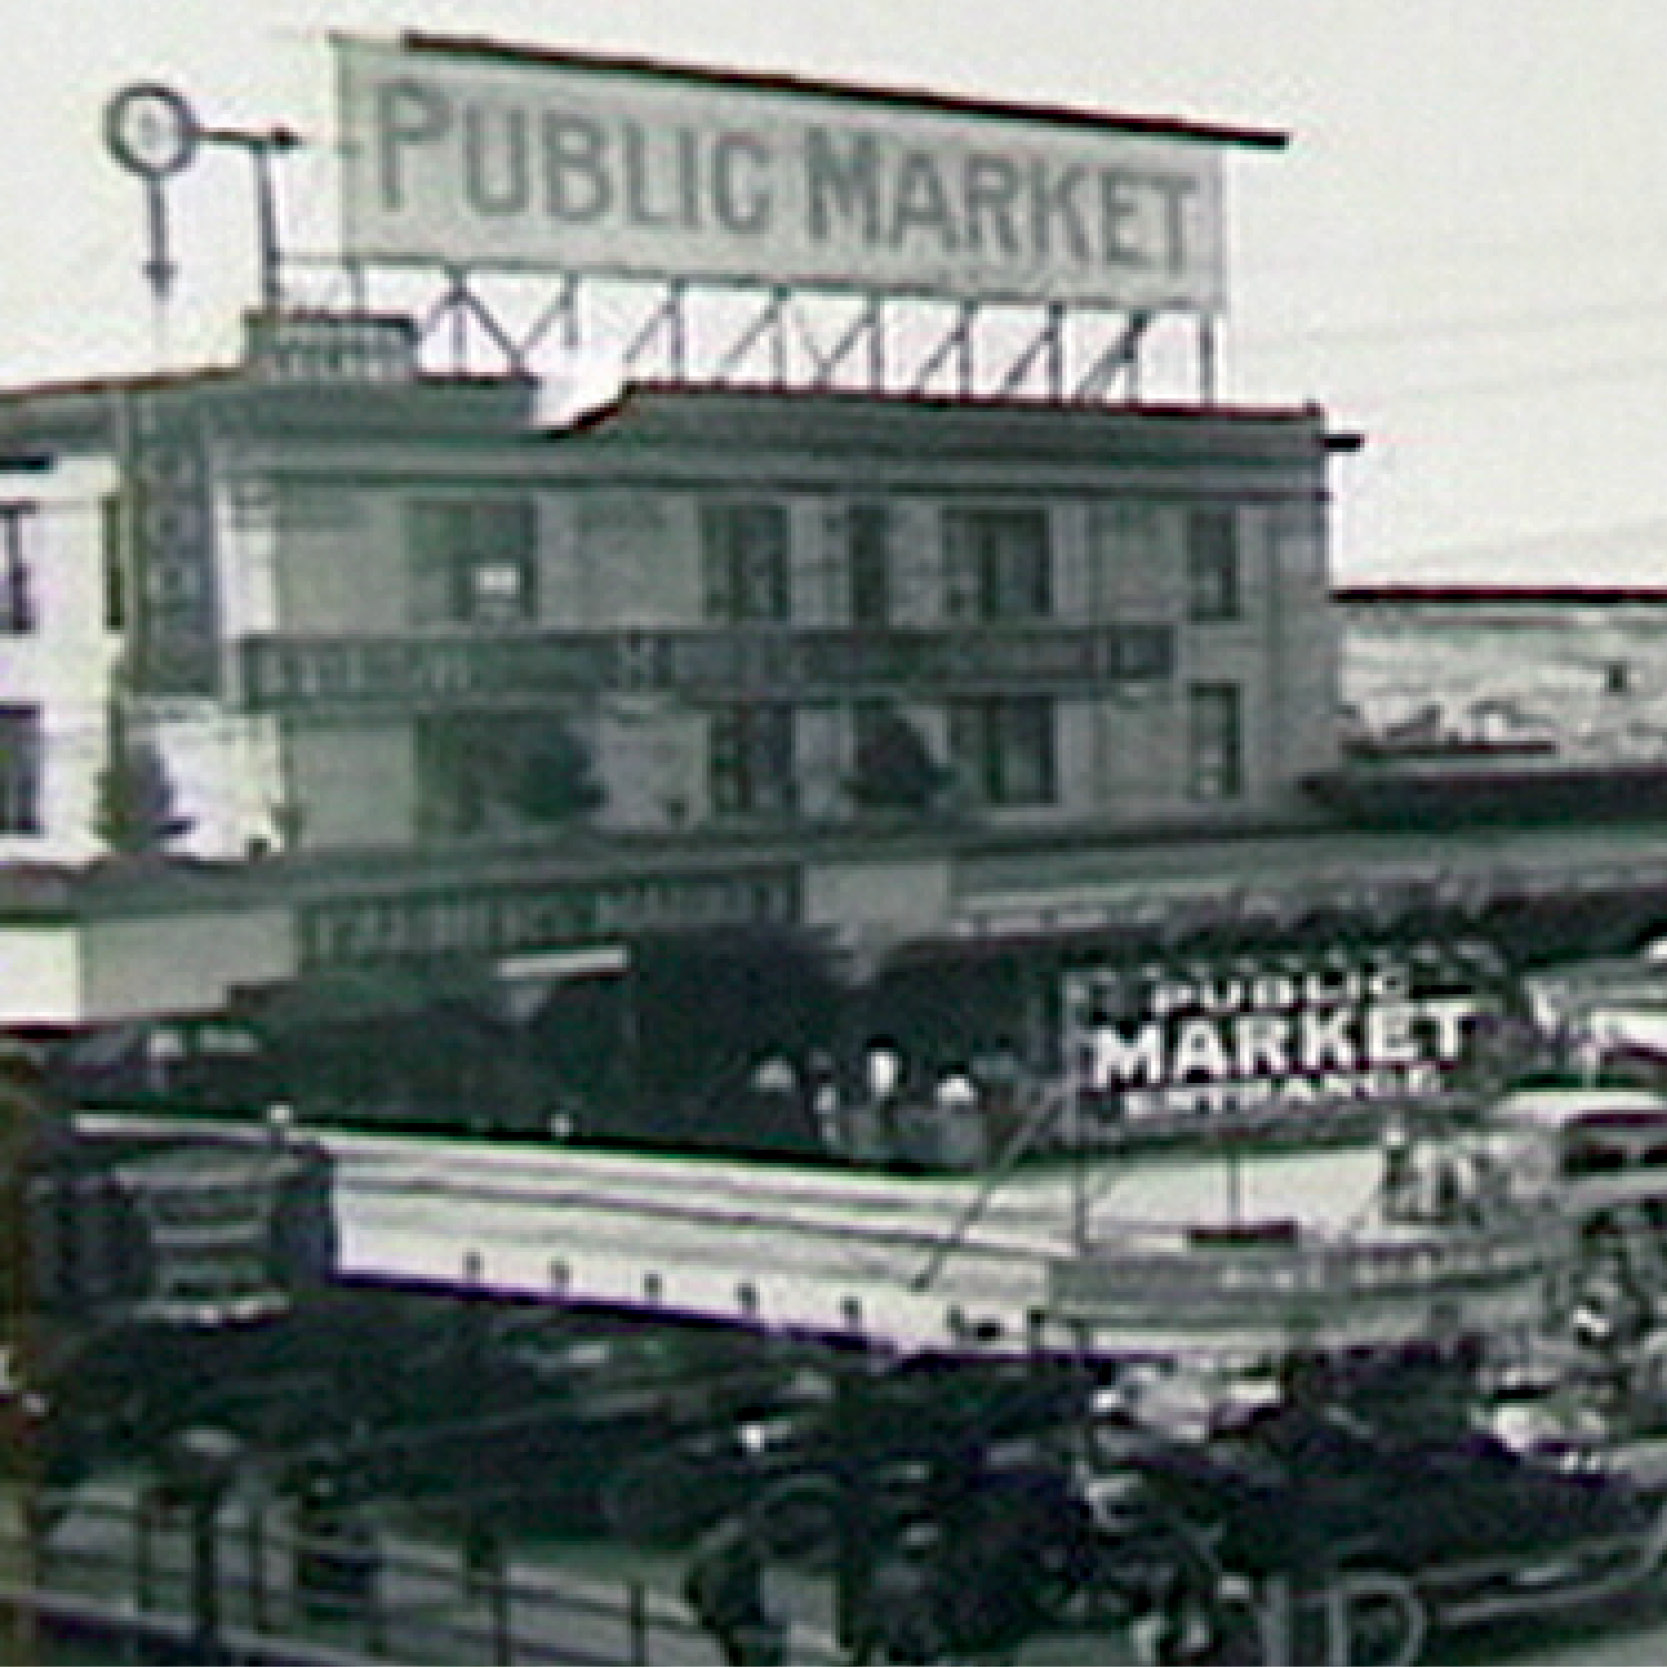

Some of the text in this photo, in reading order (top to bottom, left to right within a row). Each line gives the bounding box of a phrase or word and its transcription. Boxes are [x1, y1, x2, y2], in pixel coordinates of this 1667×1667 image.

[374, 80, 1197, 276] PUBLIC MARKET
[1152, 968, 1410, 1015] PUBLIC
[1092, 1000, 1478, 1087] MARKET
